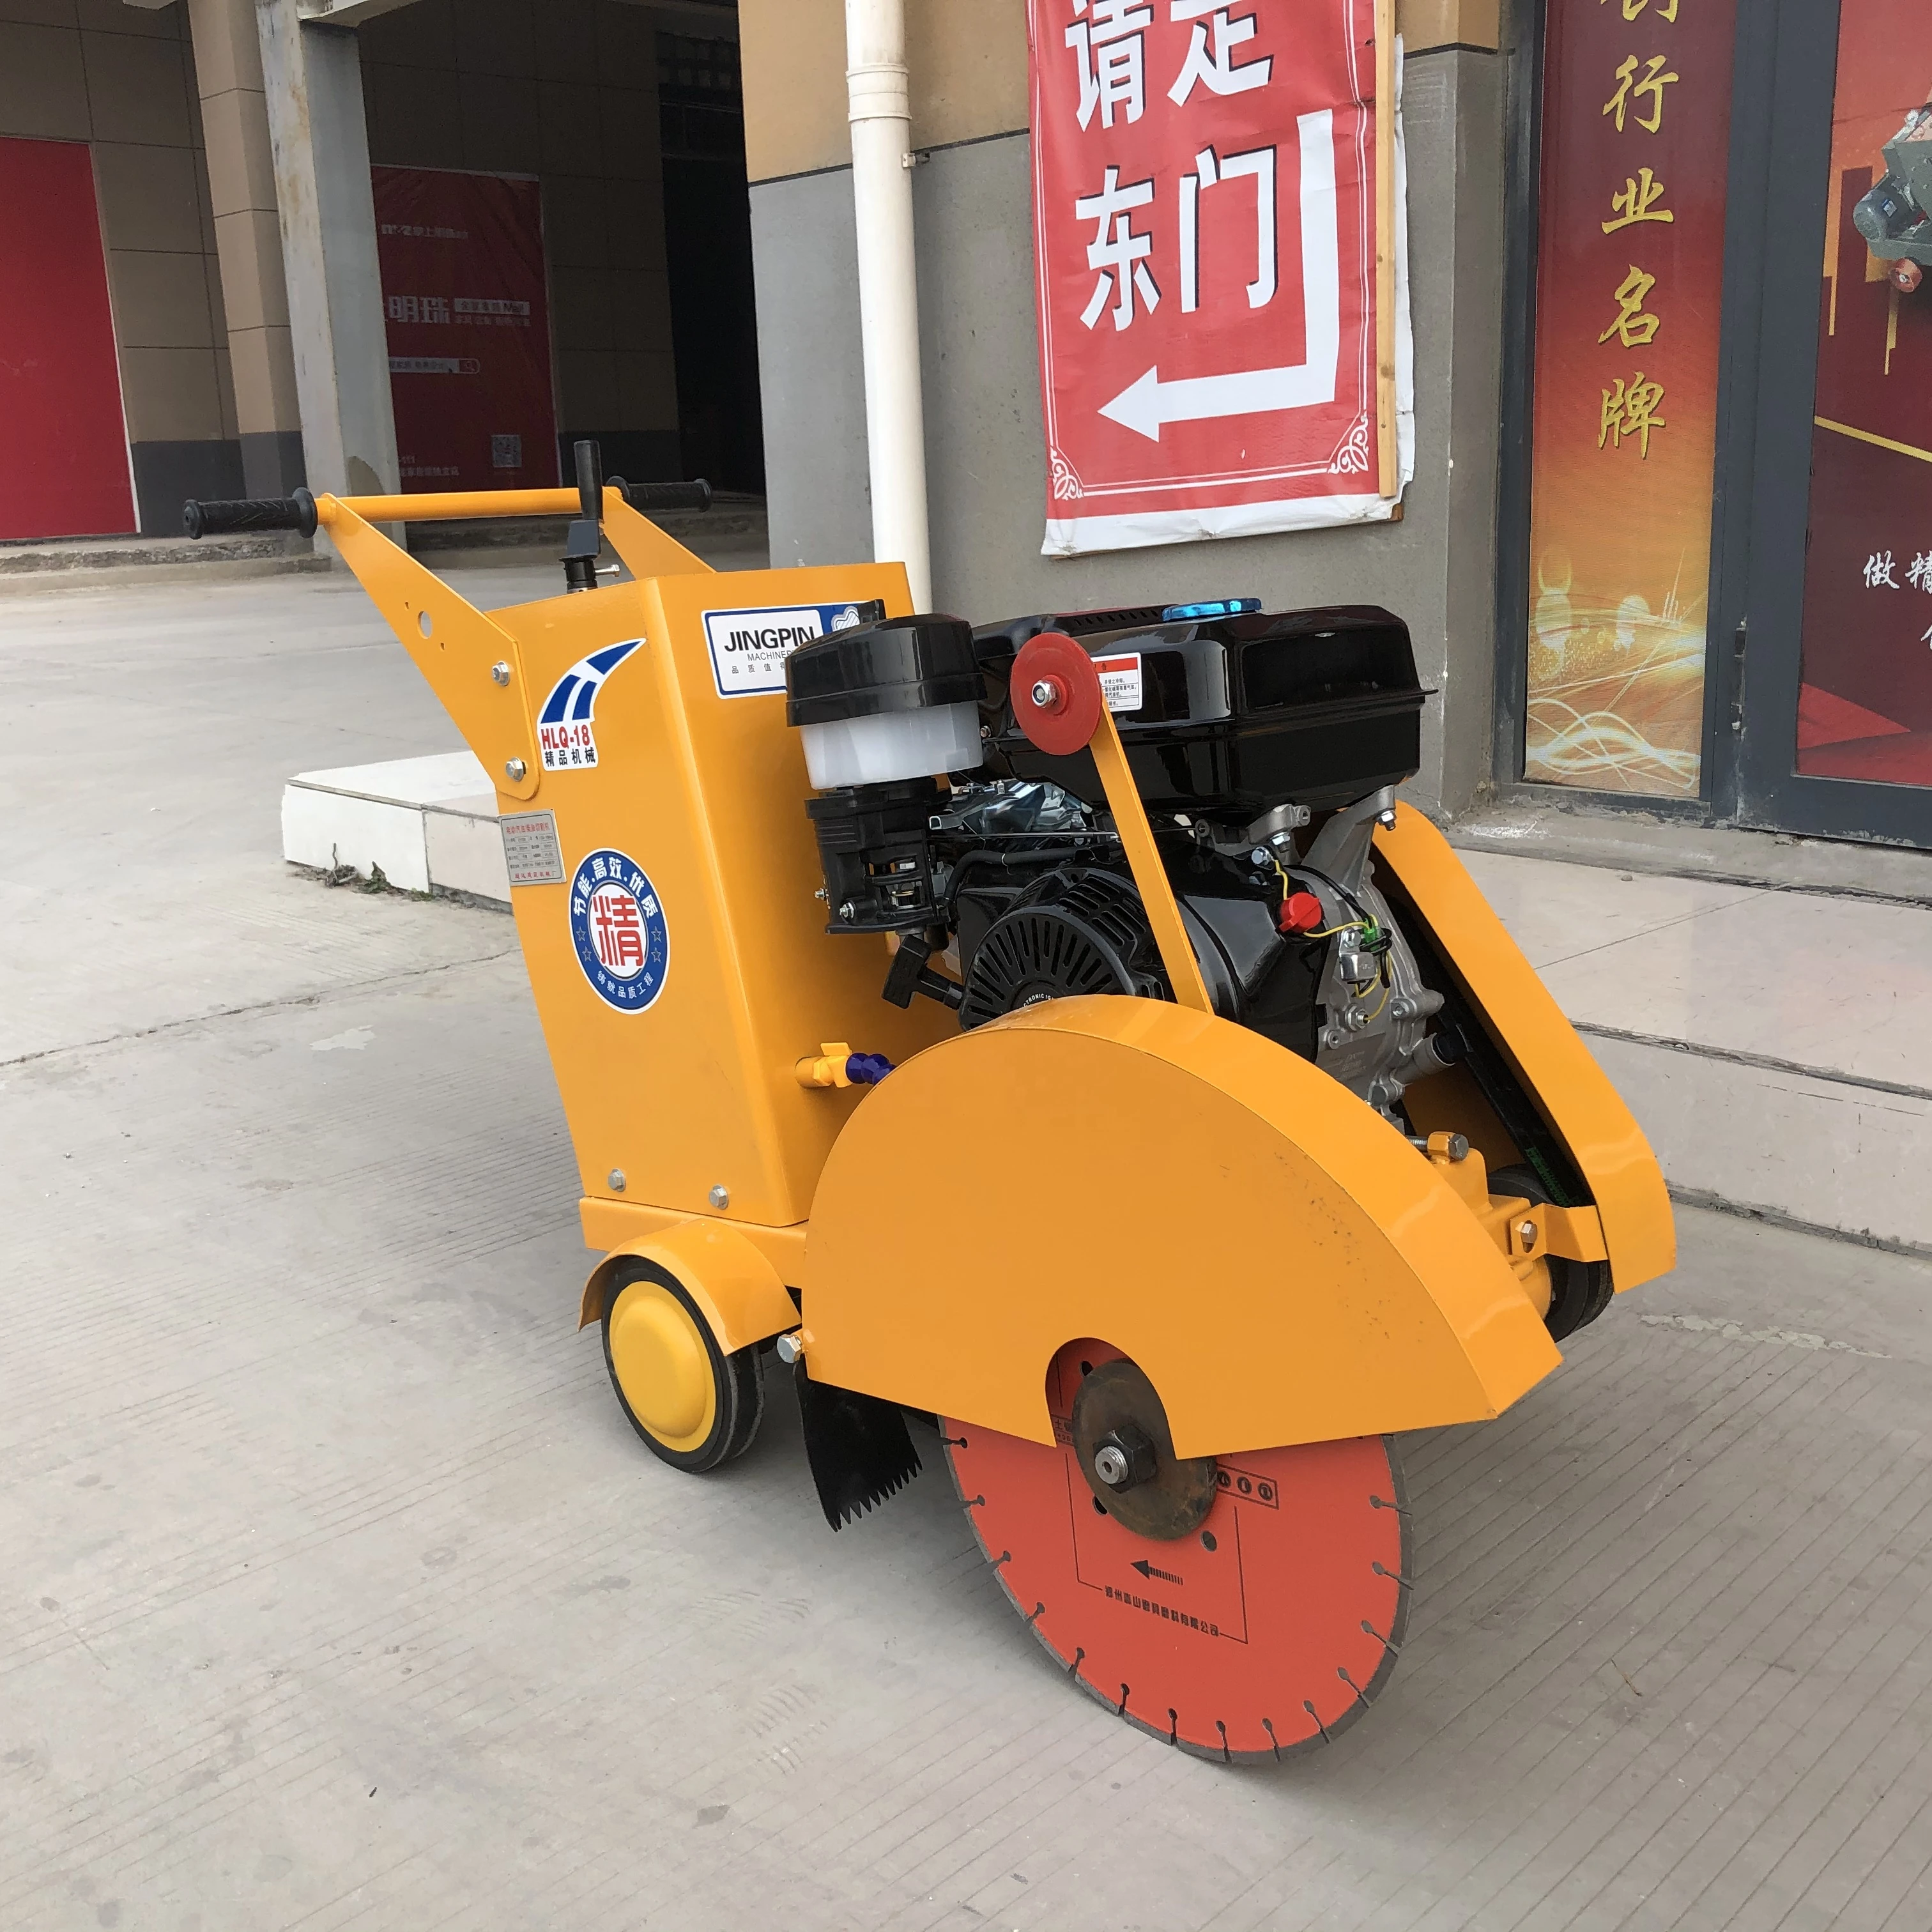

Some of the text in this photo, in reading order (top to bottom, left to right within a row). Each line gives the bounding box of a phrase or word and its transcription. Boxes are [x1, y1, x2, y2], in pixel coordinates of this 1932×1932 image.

[1075, 144, 1278, 331] 东门
[385, 295, 450, 325] 明珠
[724, 626, 815, 652] JINGPIN
[747, 650, 795, 662] MACHINER
[540, 724, 590, 750] HLQ-18
[544, 746, 595, 767] 精品机械
[592, 895, 644, 967] 精
